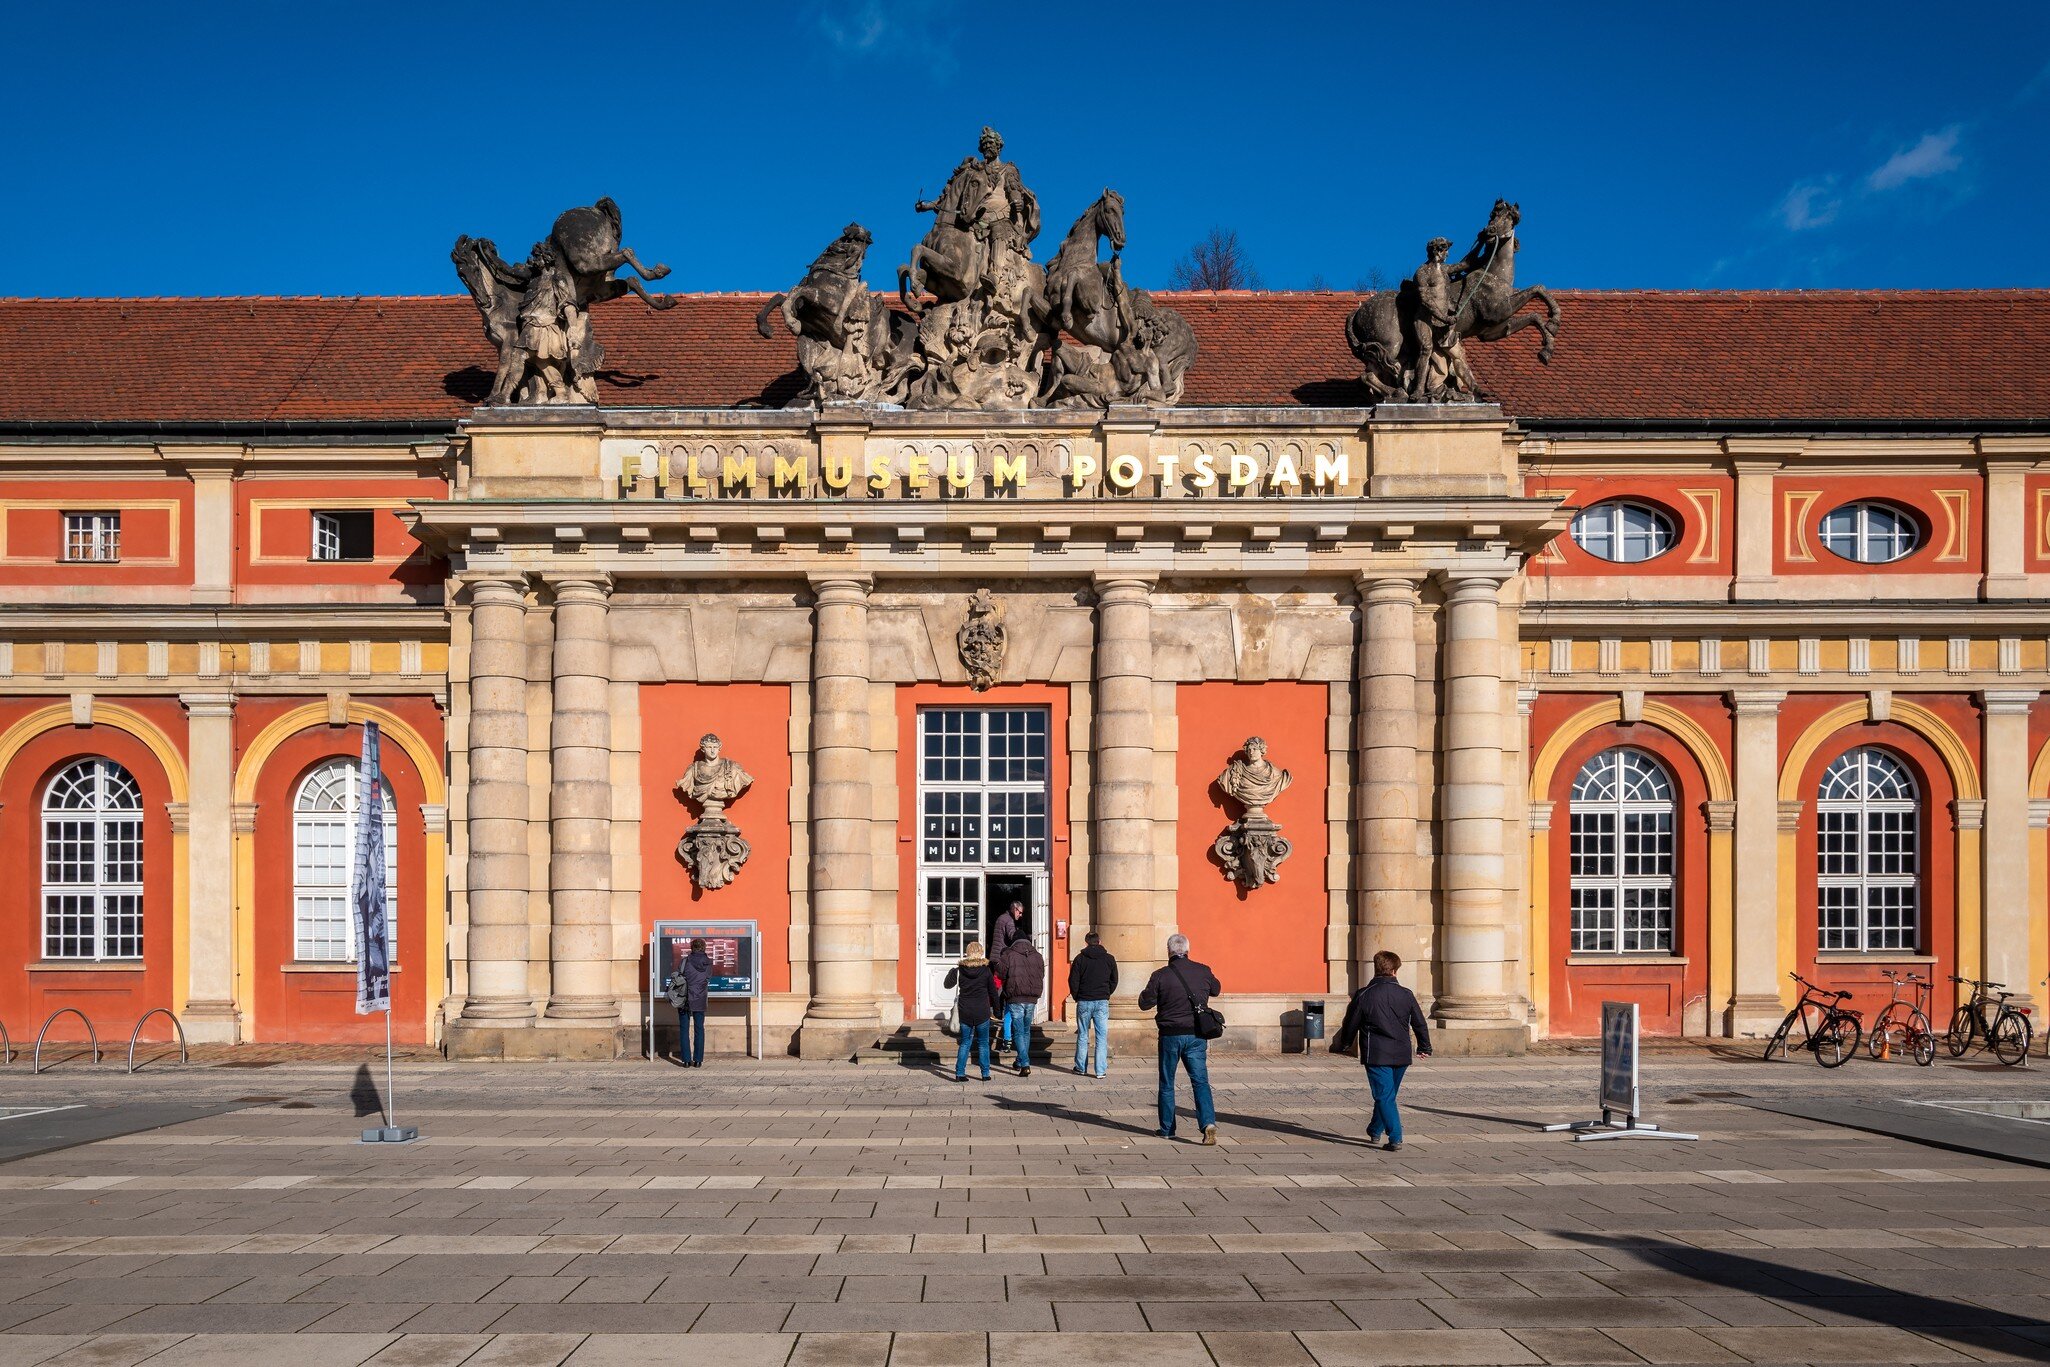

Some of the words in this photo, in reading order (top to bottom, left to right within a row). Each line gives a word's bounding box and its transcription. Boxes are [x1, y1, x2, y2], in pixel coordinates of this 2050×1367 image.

[622, 455, 1027, 488] FILMMUSEUM
[1073, 454, 1349, 488] POTSDAM
[930, 822, 1001, 832] FILM
[929, 846, 1040, 856] MUSEUM
